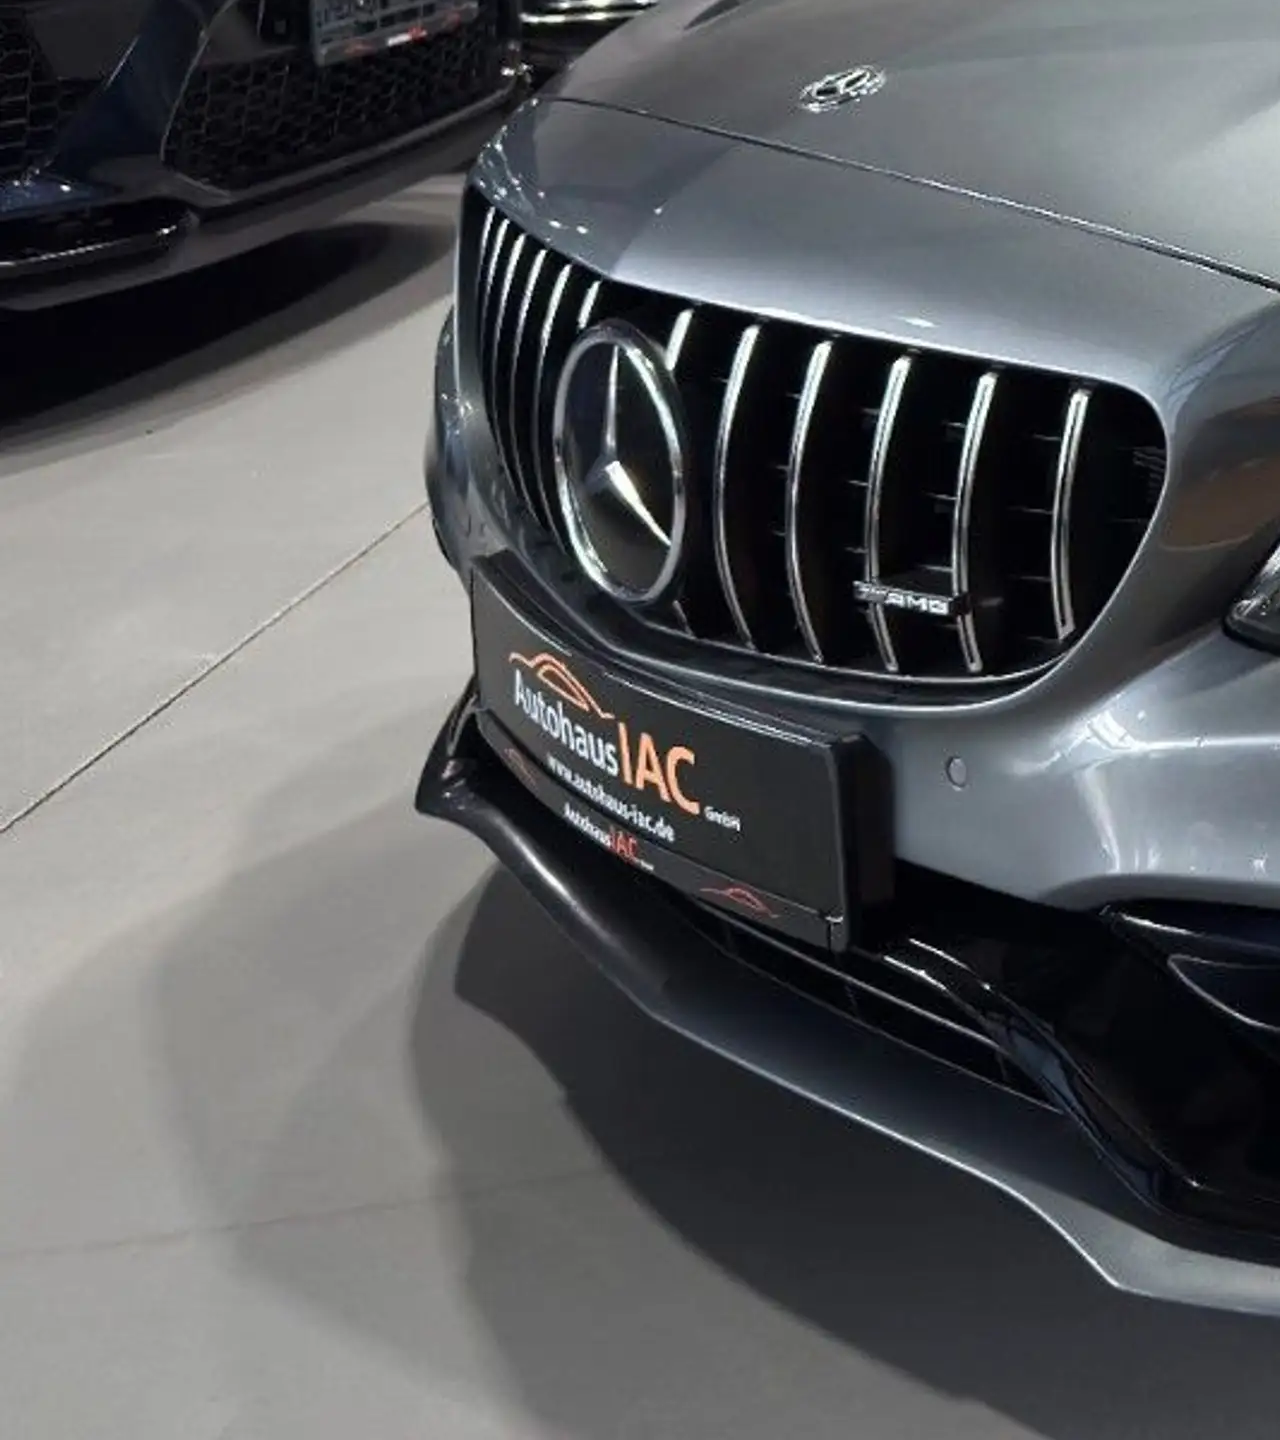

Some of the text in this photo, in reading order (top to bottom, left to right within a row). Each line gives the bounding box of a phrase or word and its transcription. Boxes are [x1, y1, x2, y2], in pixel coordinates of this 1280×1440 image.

[884, 592, 949, 616] AMG
[514, 668, 619, 777] Autohaus
[618, 721, 700, 815] IAC
